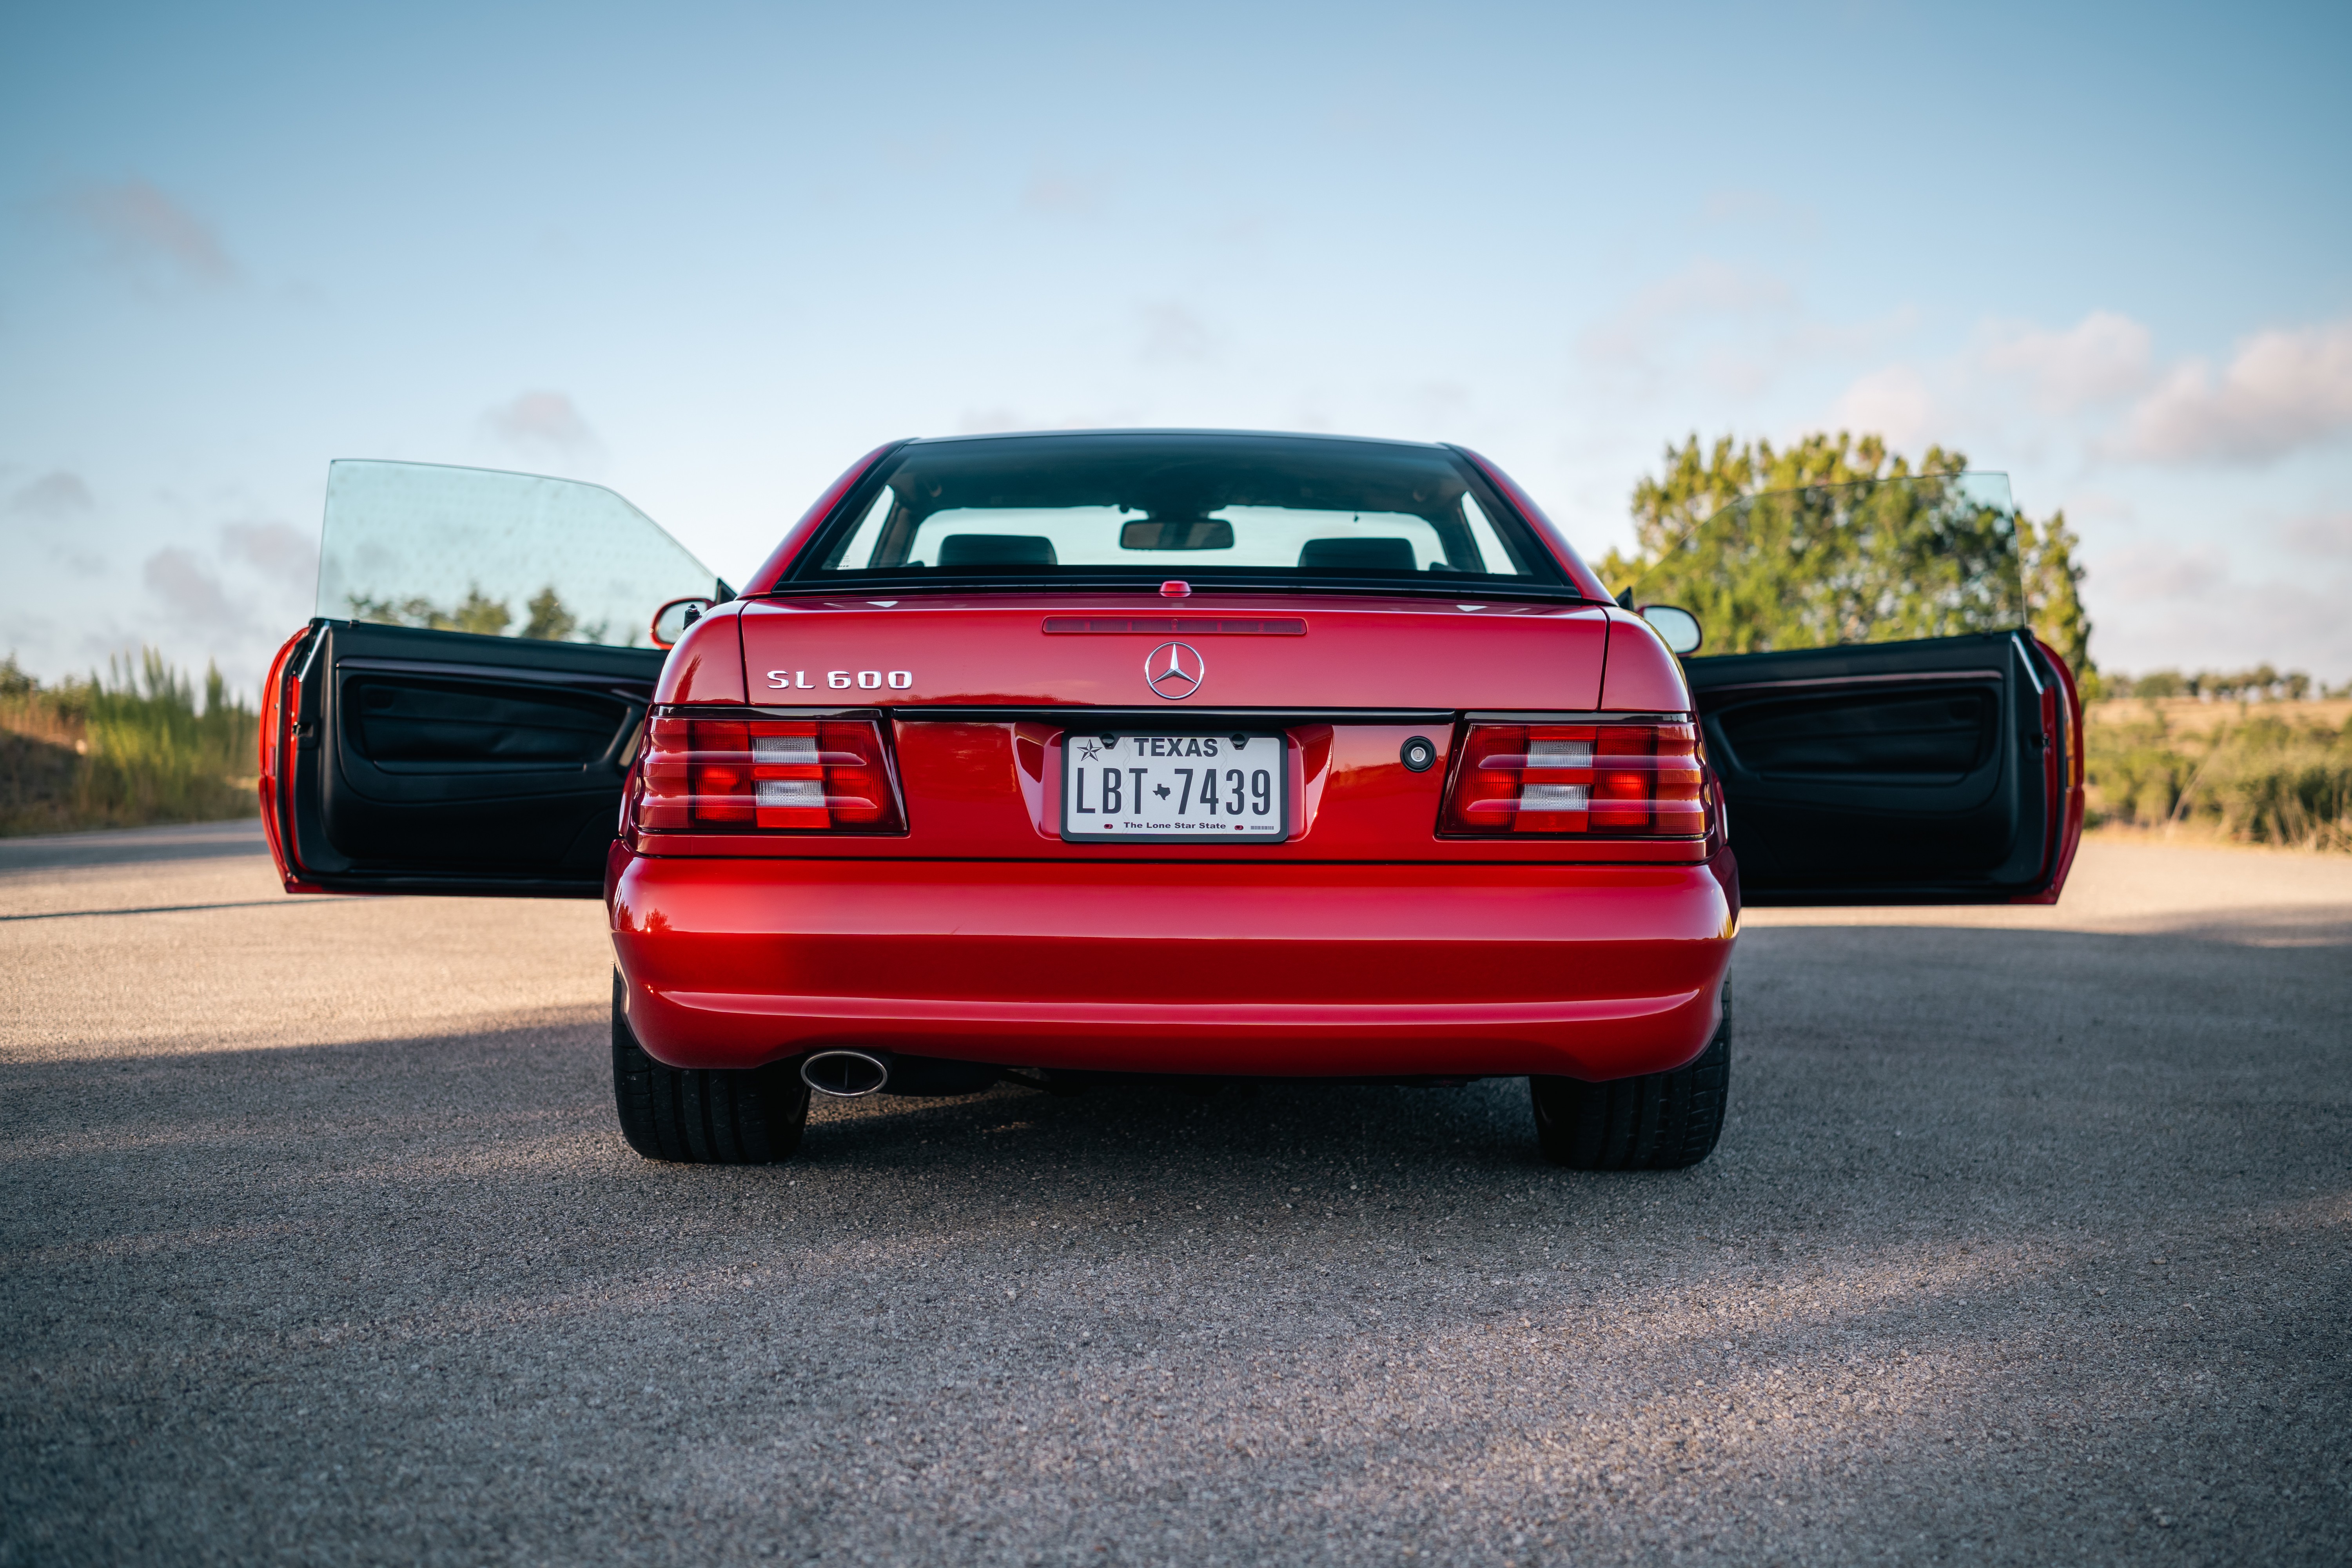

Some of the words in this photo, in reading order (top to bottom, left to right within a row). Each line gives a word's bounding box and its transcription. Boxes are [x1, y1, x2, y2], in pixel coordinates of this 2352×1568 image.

[767, 670, 816, 690] SL
[828, 670, 912, 690] 600
[1134, 738, 1218, 757] TEXAS
[1076, 768, 1148, 814] LBT
[1174, 768, 1271, 815] 7439
